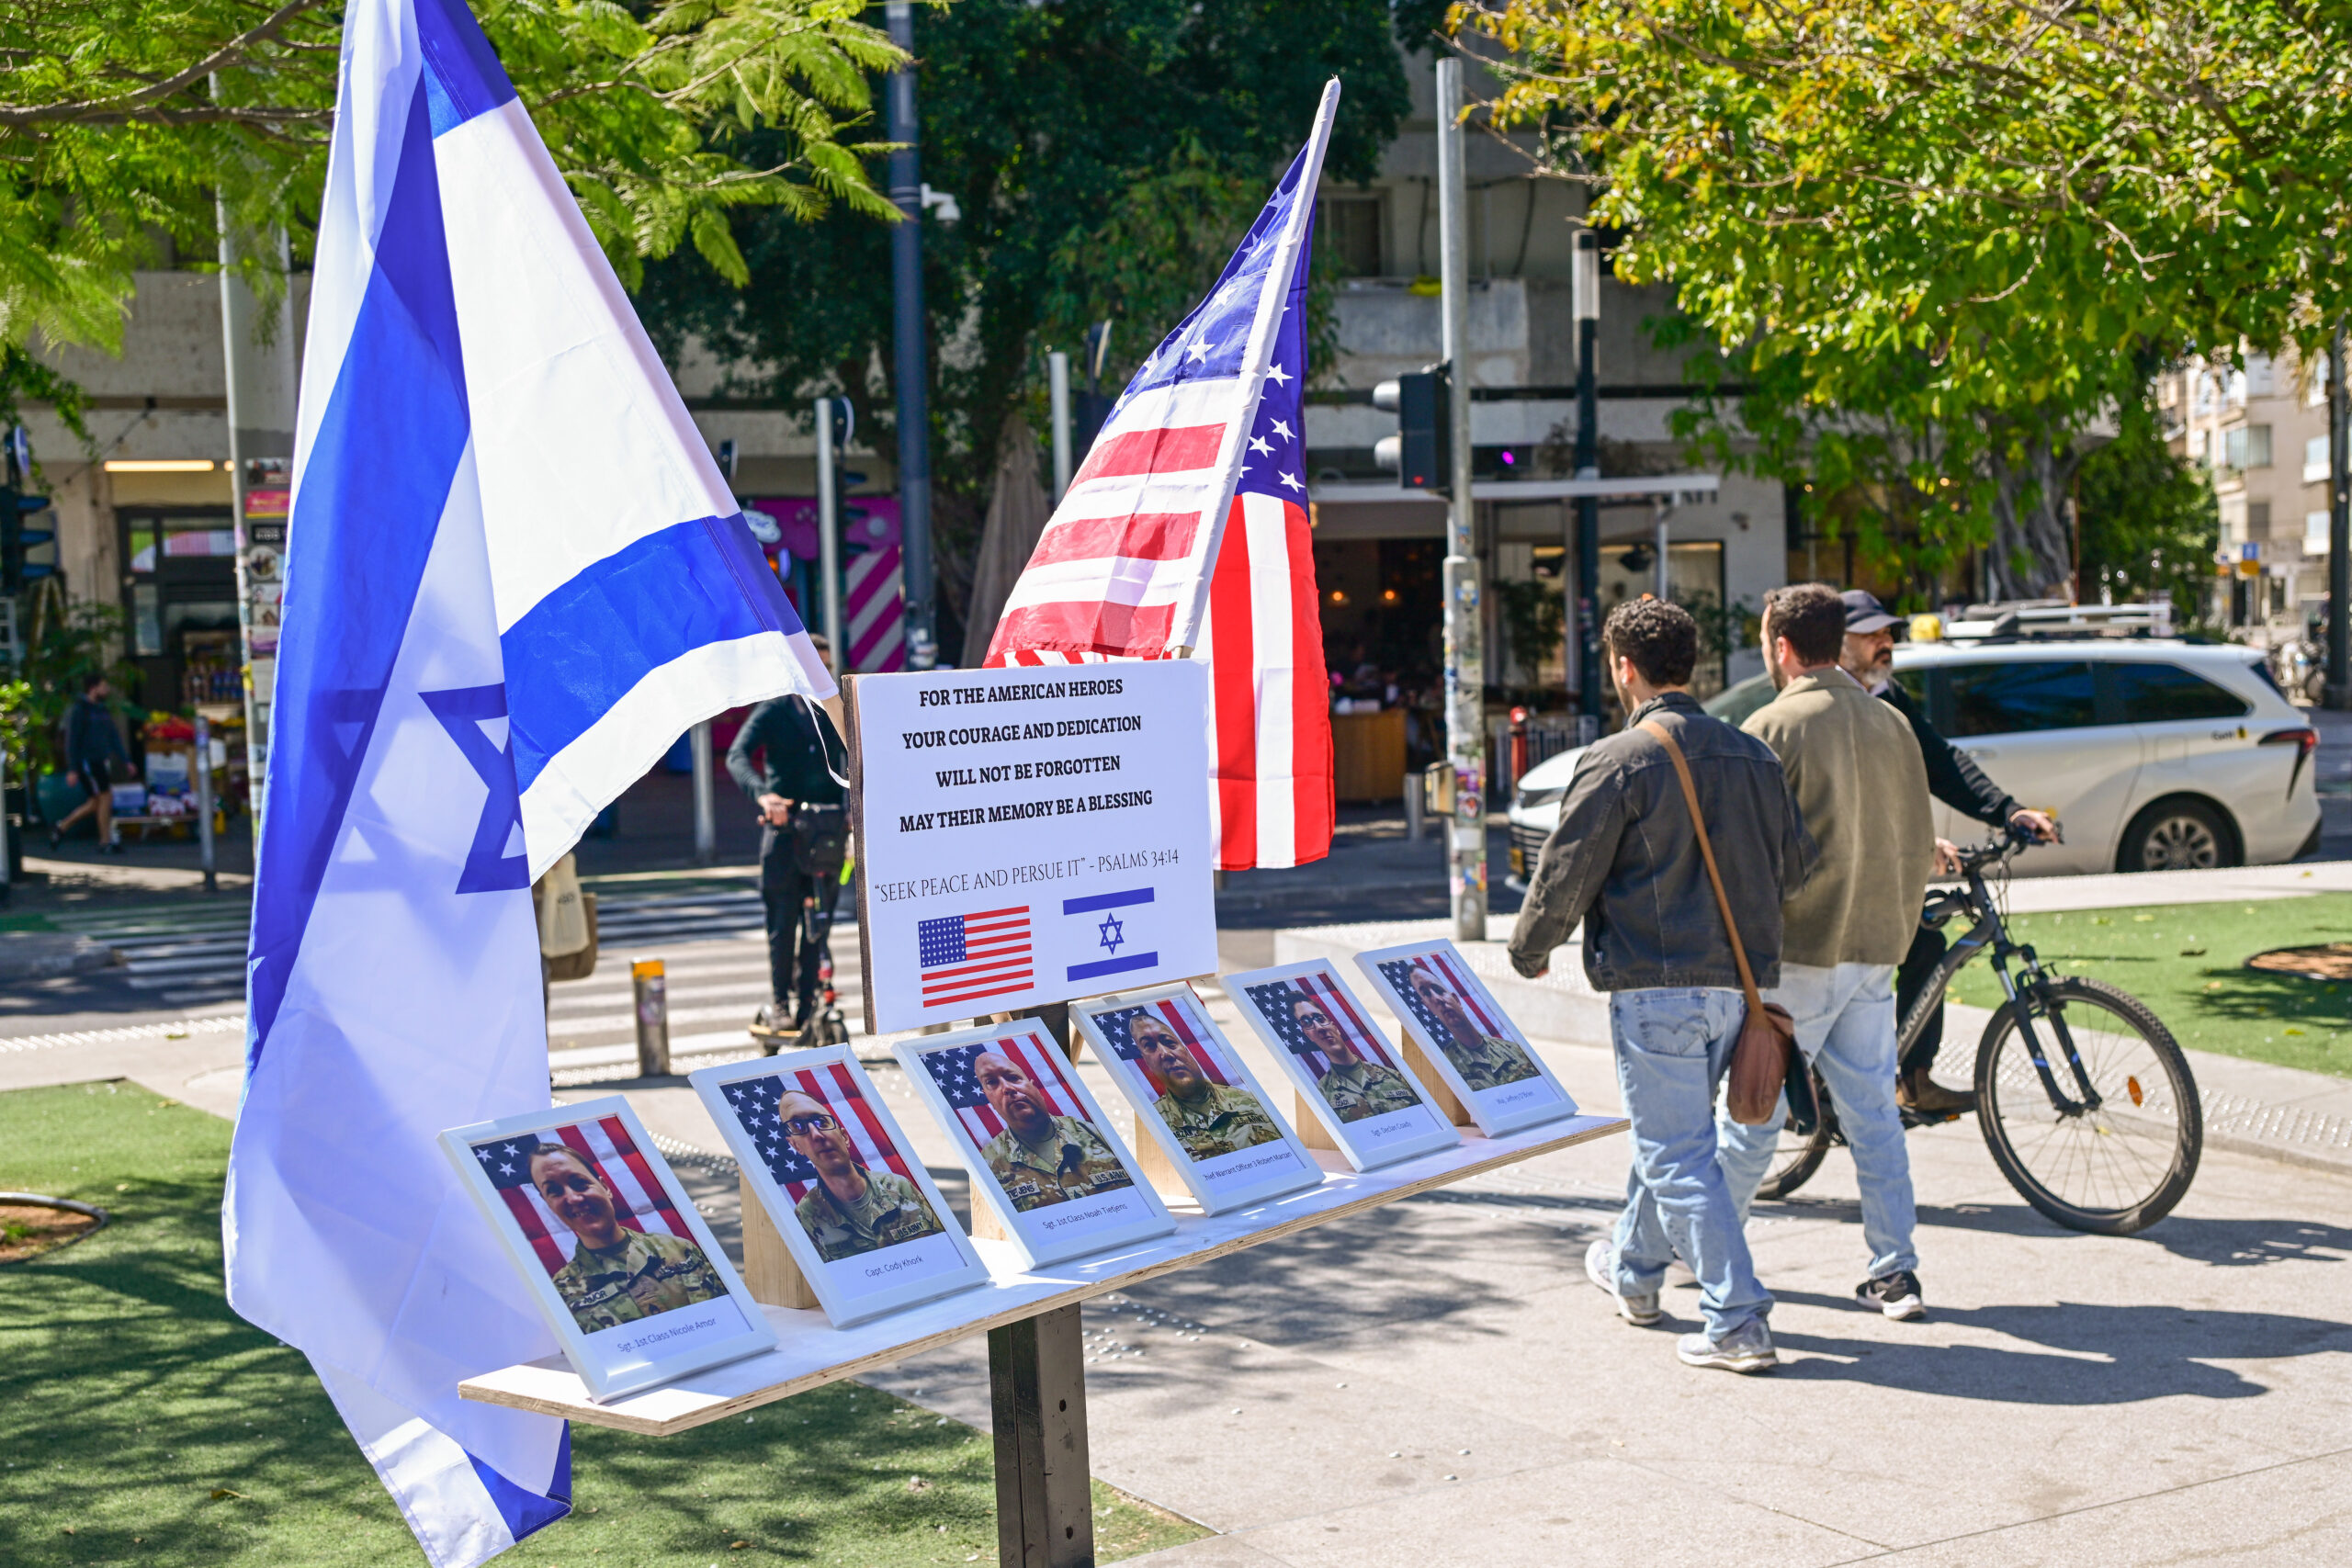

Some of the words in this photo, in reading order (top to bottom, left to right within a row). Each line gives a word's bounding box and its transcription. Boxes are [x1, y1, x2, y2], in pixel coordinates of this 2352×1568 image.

[919, 689, 951, 707] FOR
[953, 687, 985, 705] THE
[987, 682, 1066, 703] AMERICAN
[1069, 678, 1124, 697] HEROES
[902, 730, 947, 750] YOUR
[948, 724, 1021, 746] COURAGE
[1023, 722, 1055, 739] AND
[1057, 715, 1141, 737] DEDICATION
[935, 768, 977, 788] WILL
[978, 765, 1012, 784] NOT
[1013, 762, 1033, 780] BE
[1035, 755, 1120, 778] FORGOTTEN
[899, 813, 934, 832] MAY
[937, 807, 986, 829] THEIR
[988, 800, 1054, 823] MEMORY
[1056, 798, 1074, 815] BE
[1076, 796, 1087, 813] A
[1088, 790, 1153, 811] BLESSING
[921, 874, 969, 897] PEACE
[973, 869, 1008, 890] AND
[1012, 861, 1064, 885] PERSUE
[1098, 850, 1148, 873] PSALMS
[1150, 848, 1179, 868] 34:14
[1173, 1129, 1193, 1139] ARZAN
[1110, 1169, 1126, 1180] ARMY
[1216, 1168, 1237, 1179] Warrant
[1235, 1163, 1253, 1173] Officer
[1257, 1156, 1274, 1166] Robert
[1042, 1221, 1057, 1230] Sgt.
[1057, 1217, 1069, 1226] 1st
[1067, 1213, 1085, 1224] Class
[1084, 1208, 1102, 1219] Noah
[1102, 1202, 1128, 1214] Tietjens
[865, 1268, 885, 1278] Capt.
[884, 1261, 903, 1272] Cody
[902, 1255, 924, 1268] Khork
[616, 1342, 636, 1353] Sgt.
[635, 1338, 649, 1348] 1st
[648, 1331, 670, 1344] Class
[669, 1324, 695, 1338] Nicole
[695, 1317, 717, 1330] Amor
